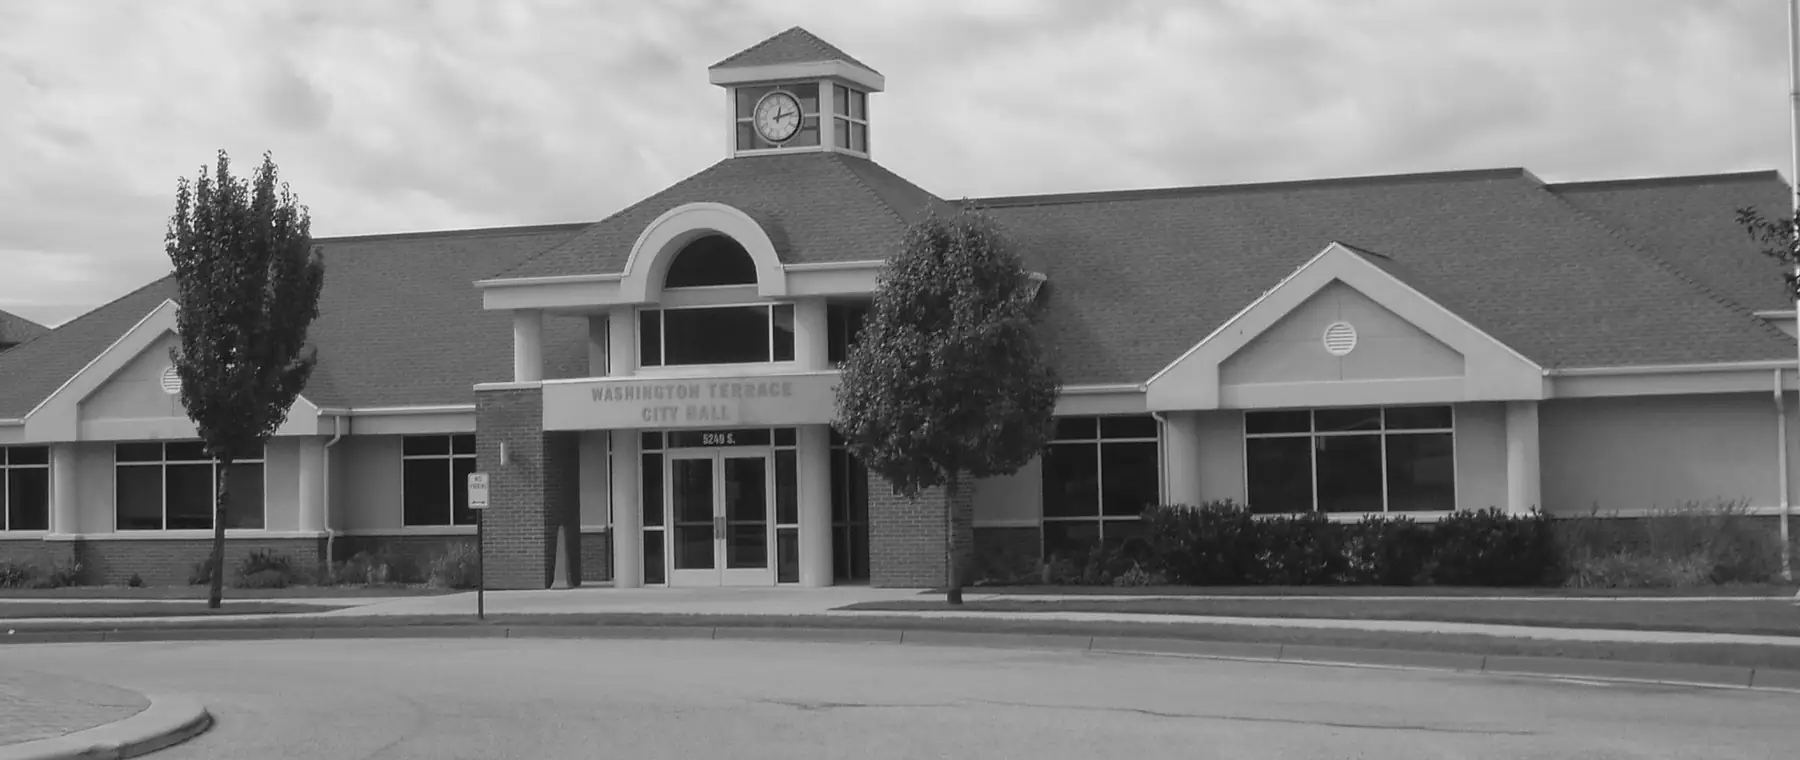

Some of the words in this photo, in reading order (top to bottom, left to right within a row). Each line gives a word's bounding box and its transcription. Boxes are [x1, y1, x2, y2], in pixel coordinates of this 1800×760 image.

[591, 384, 699, 402] WASHINGTON
[708, 382, 793, 398] TERRACE
[641, 406, 679, 422] CITY
[685, 405, 730, 421] HALL
